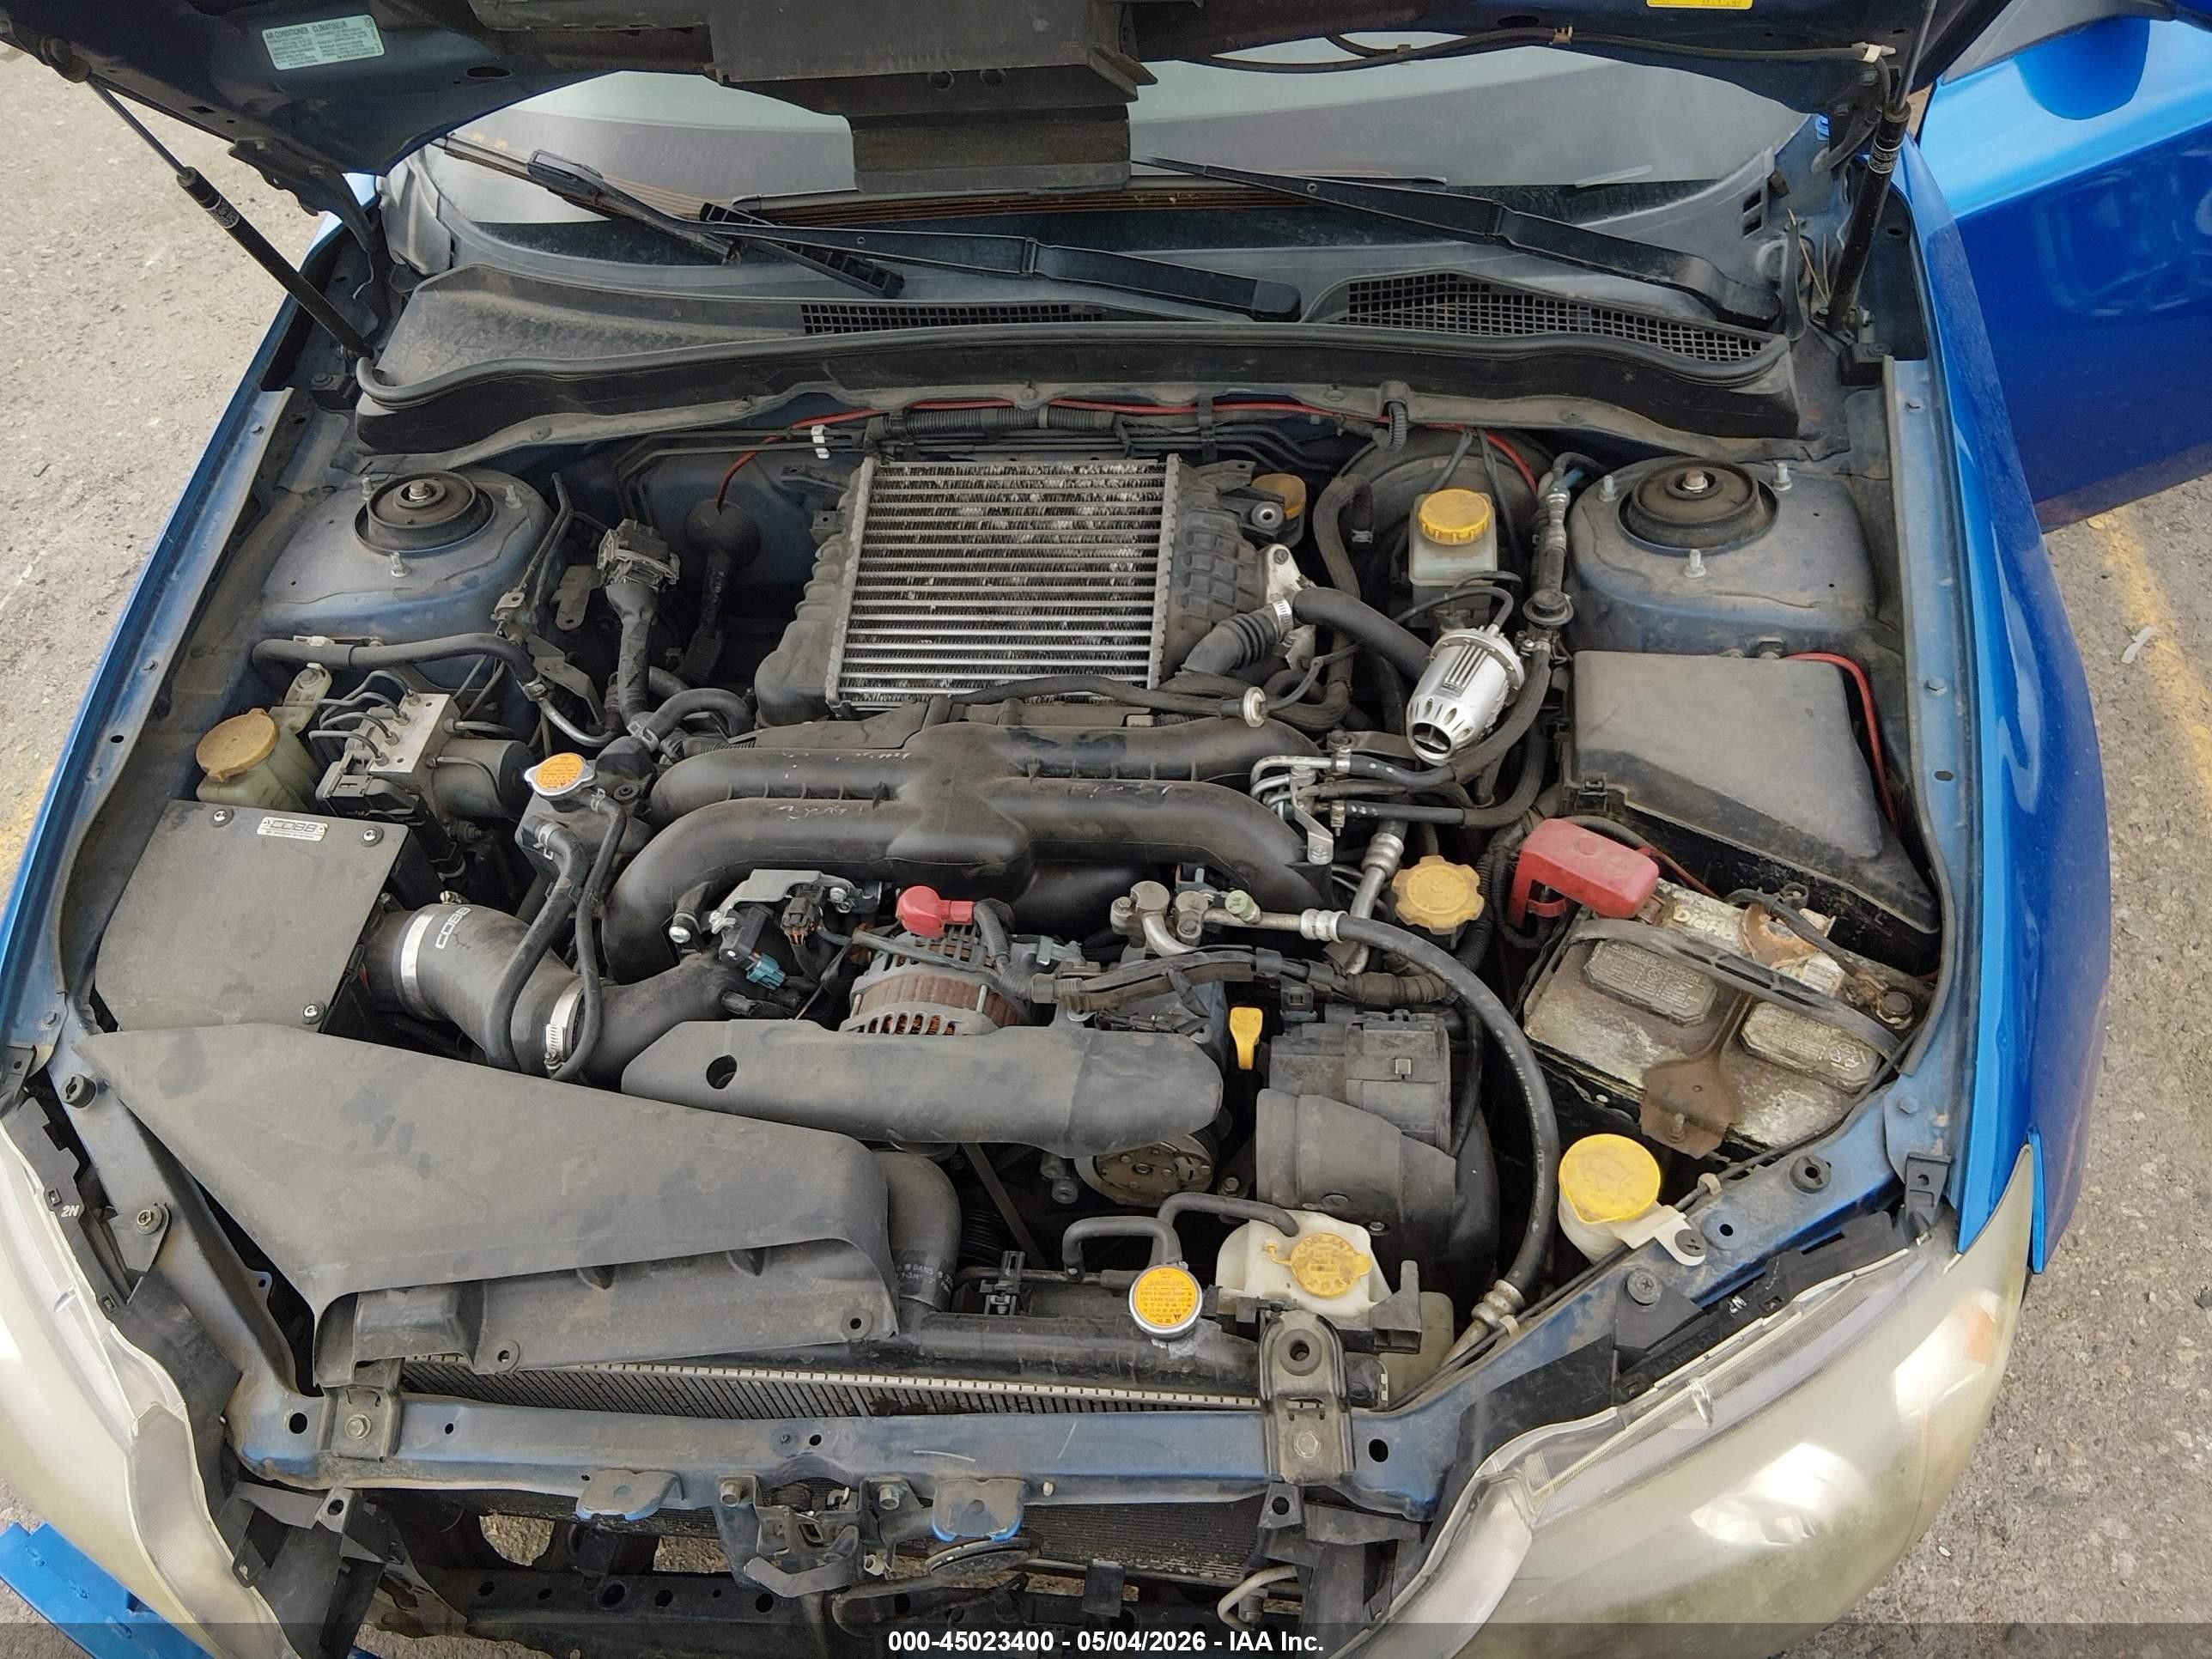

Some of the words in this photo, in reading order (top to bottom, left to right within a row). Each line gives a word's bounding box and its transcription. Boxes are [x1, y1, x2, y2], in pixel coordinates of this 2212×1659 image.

[269, 820, 318, 833] COBB
[435, 907, 471, 950] COBB
[1620, 946, 1658, 966] DANGER
[1666, 964, 1701, 984] POISON
[61, 1205, 80, 1218] 2N
